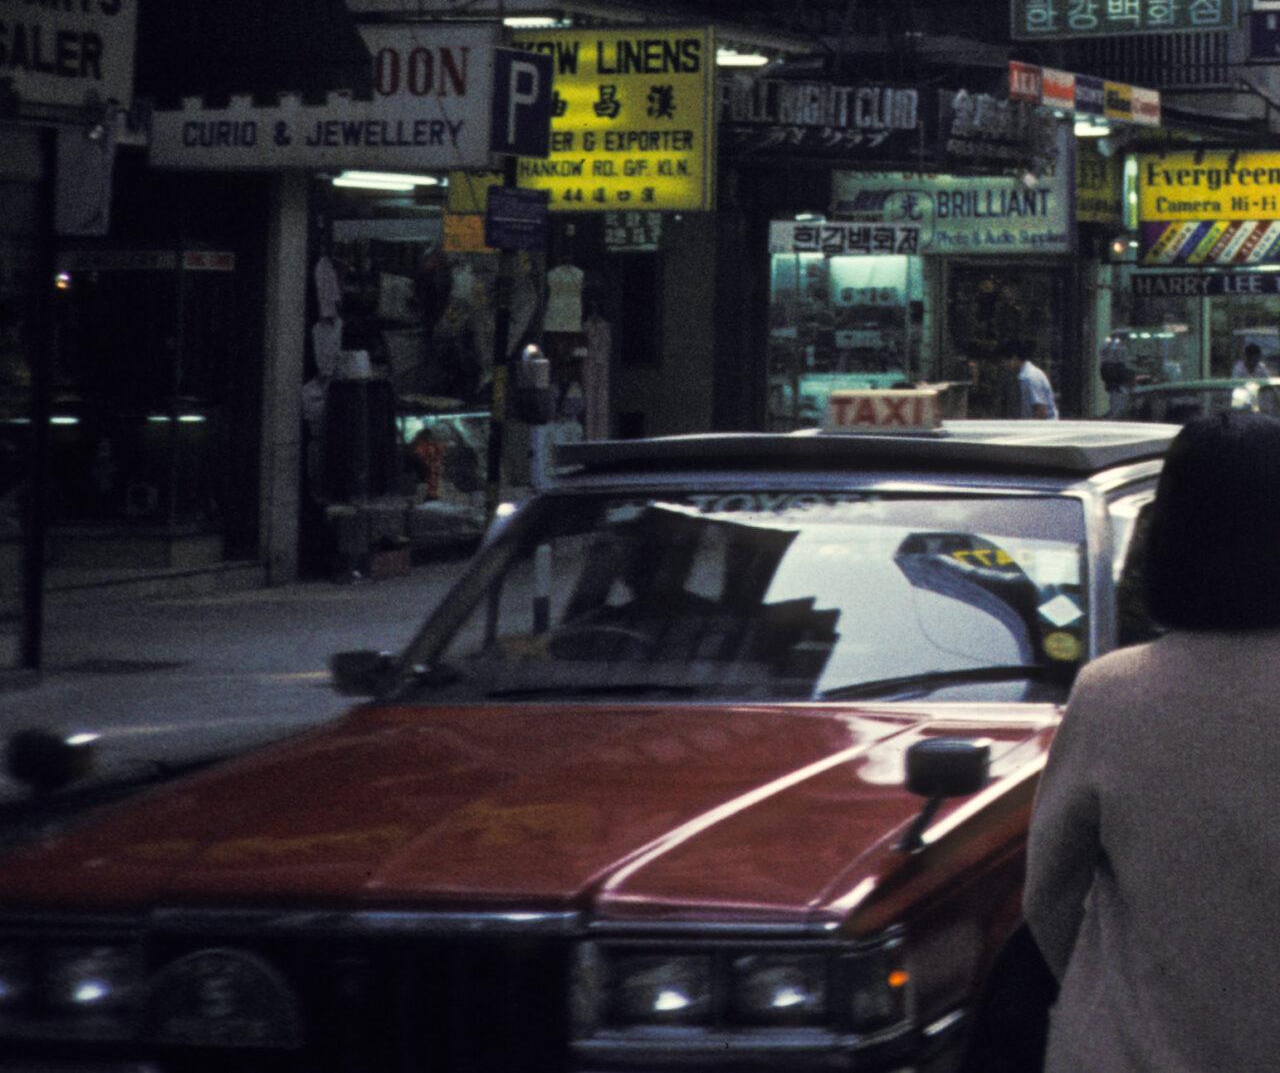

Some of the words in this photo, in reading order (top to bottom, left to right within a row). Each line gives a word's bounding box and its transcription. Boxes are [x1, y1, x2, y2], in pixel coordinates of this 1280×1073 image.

[597, 39, 700, 74] LINENS
[507, 60, 540, 145] P
[183, 121, 257, 148] CURIO
[274, 121, 292, 148] &
[306, 119, 464, 148] JEWELLERY
[604, 130, 694, 152] EXPORTER
[936, 190, 1051, 218] BRILLIANT
[1156, 196, 1222, 214] Camera
[1231, 194, 1277, 212] Hi-Fi
[1136, 276, 1209, 294] HARRY
[1223, 275, 1262, 293] LEE
[831, 397, 926, 426] TAXI
